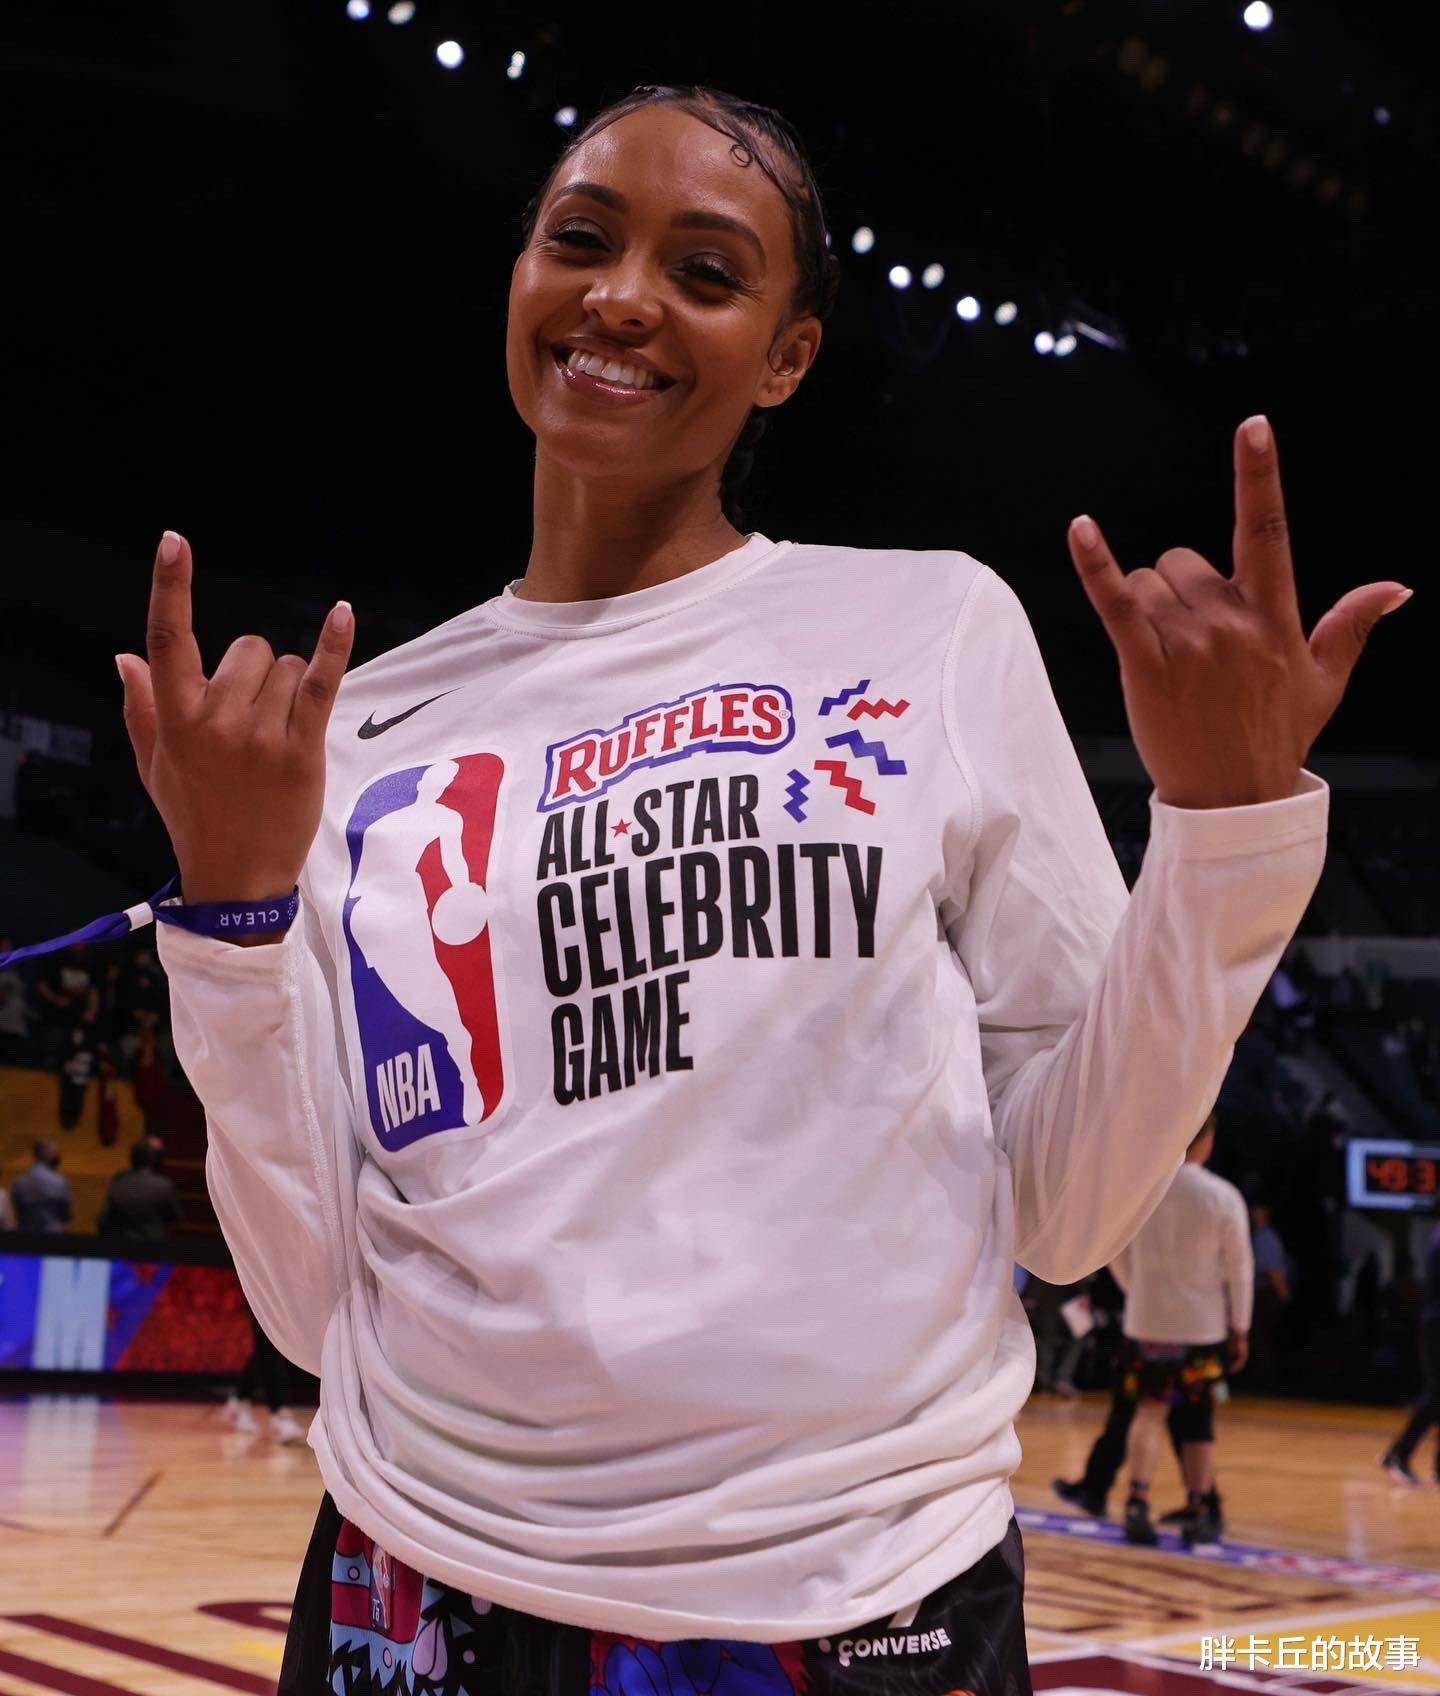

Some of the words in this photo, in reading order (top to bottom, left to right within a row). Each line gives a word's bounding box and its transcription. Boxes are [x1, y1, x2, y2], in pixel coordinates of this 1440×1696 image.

[551, 692, 783, 799] RUFFLES
[220, 909, 280, 926] CLEAR
[536, 842, 884, 998] CELEBRITY
[550, 969, 694, 1106] GAME
[376, 1042, 442, 1134] NBA
[838, 1627, 952, 1658] CONVERSE
